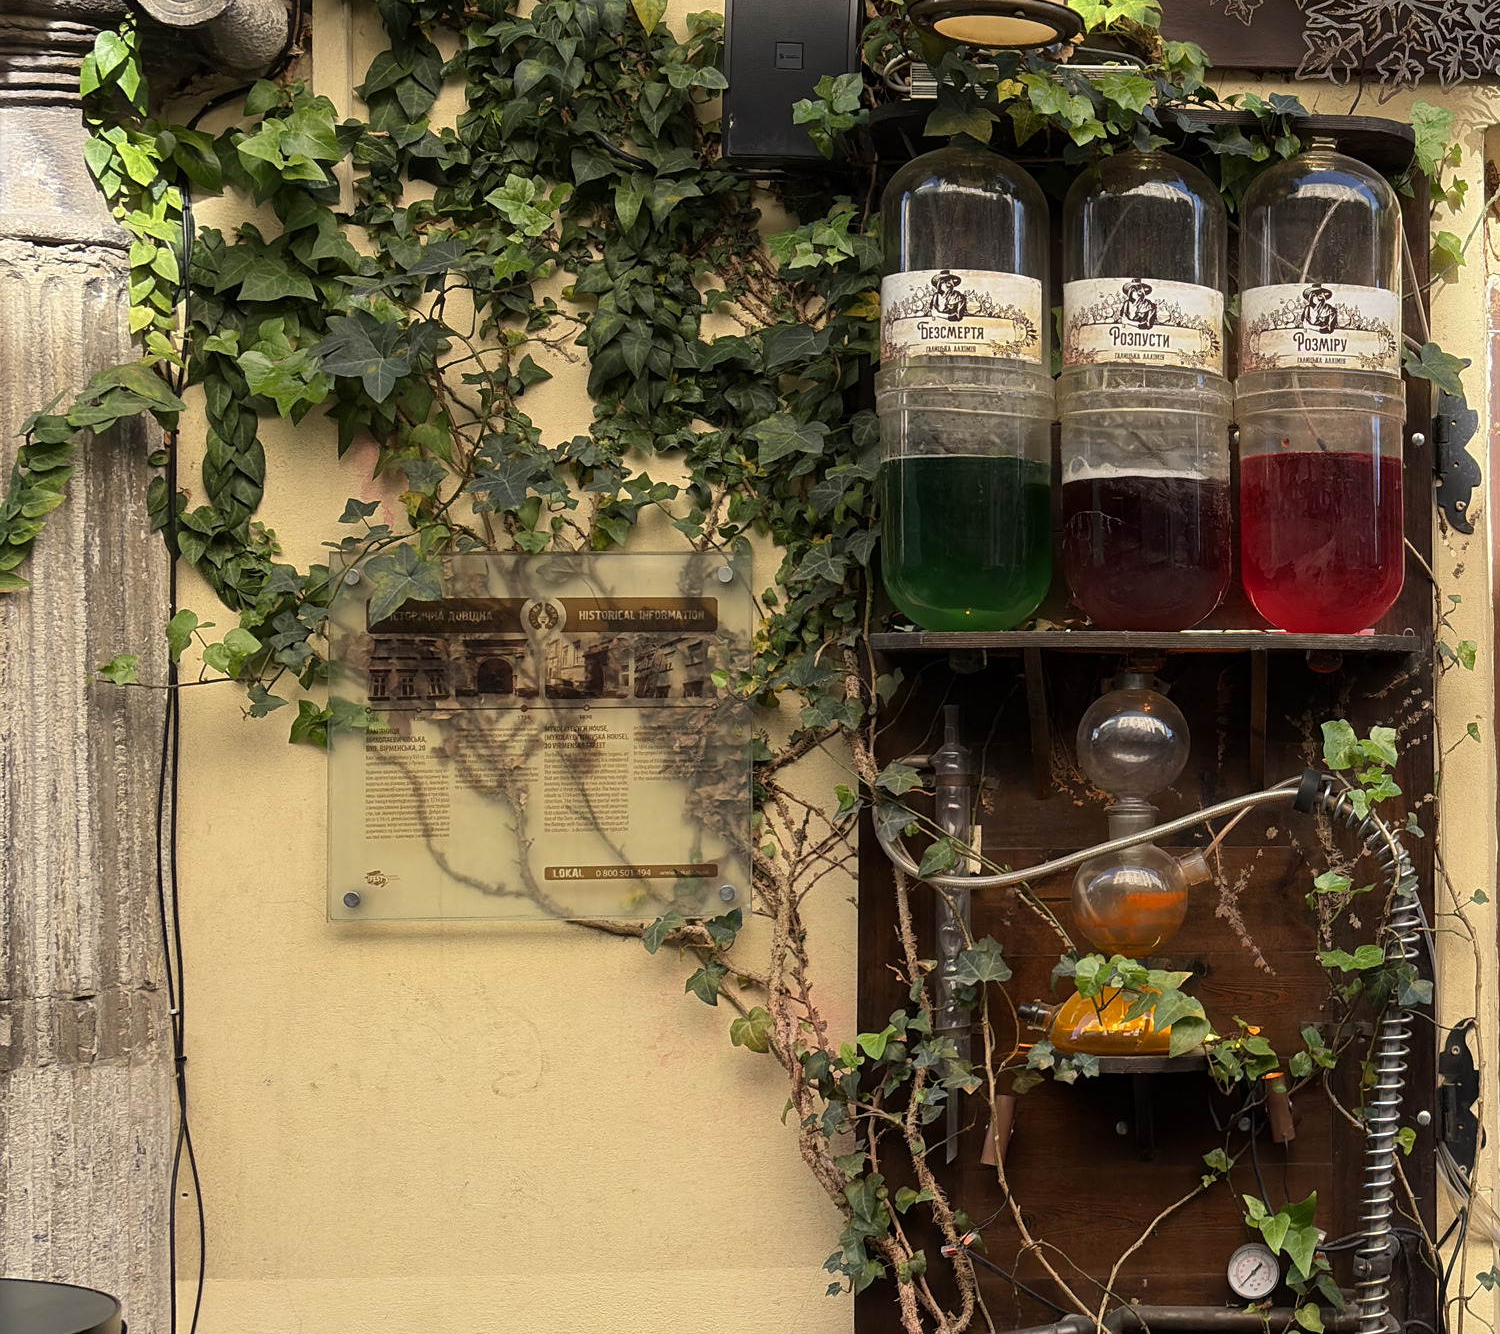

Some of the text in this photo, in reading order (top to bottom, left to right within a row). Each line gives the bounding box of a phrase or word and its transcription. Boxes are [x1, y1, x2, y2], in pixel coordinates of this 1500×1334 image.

[917, 322, 985, 340] БЕЗСМЕРТЯ
[1109, 327, 1170, 348] РОЗПУСТИ
[1293, 332, 1348, 353] РОЗМІРУ
[579, 610, 705, 621] HISTORICAL INFORMATION
[553, 869, 584, 878] LOKAL
[603, 869, 618, 877] 800
[620, 869, 634, 877] 501
